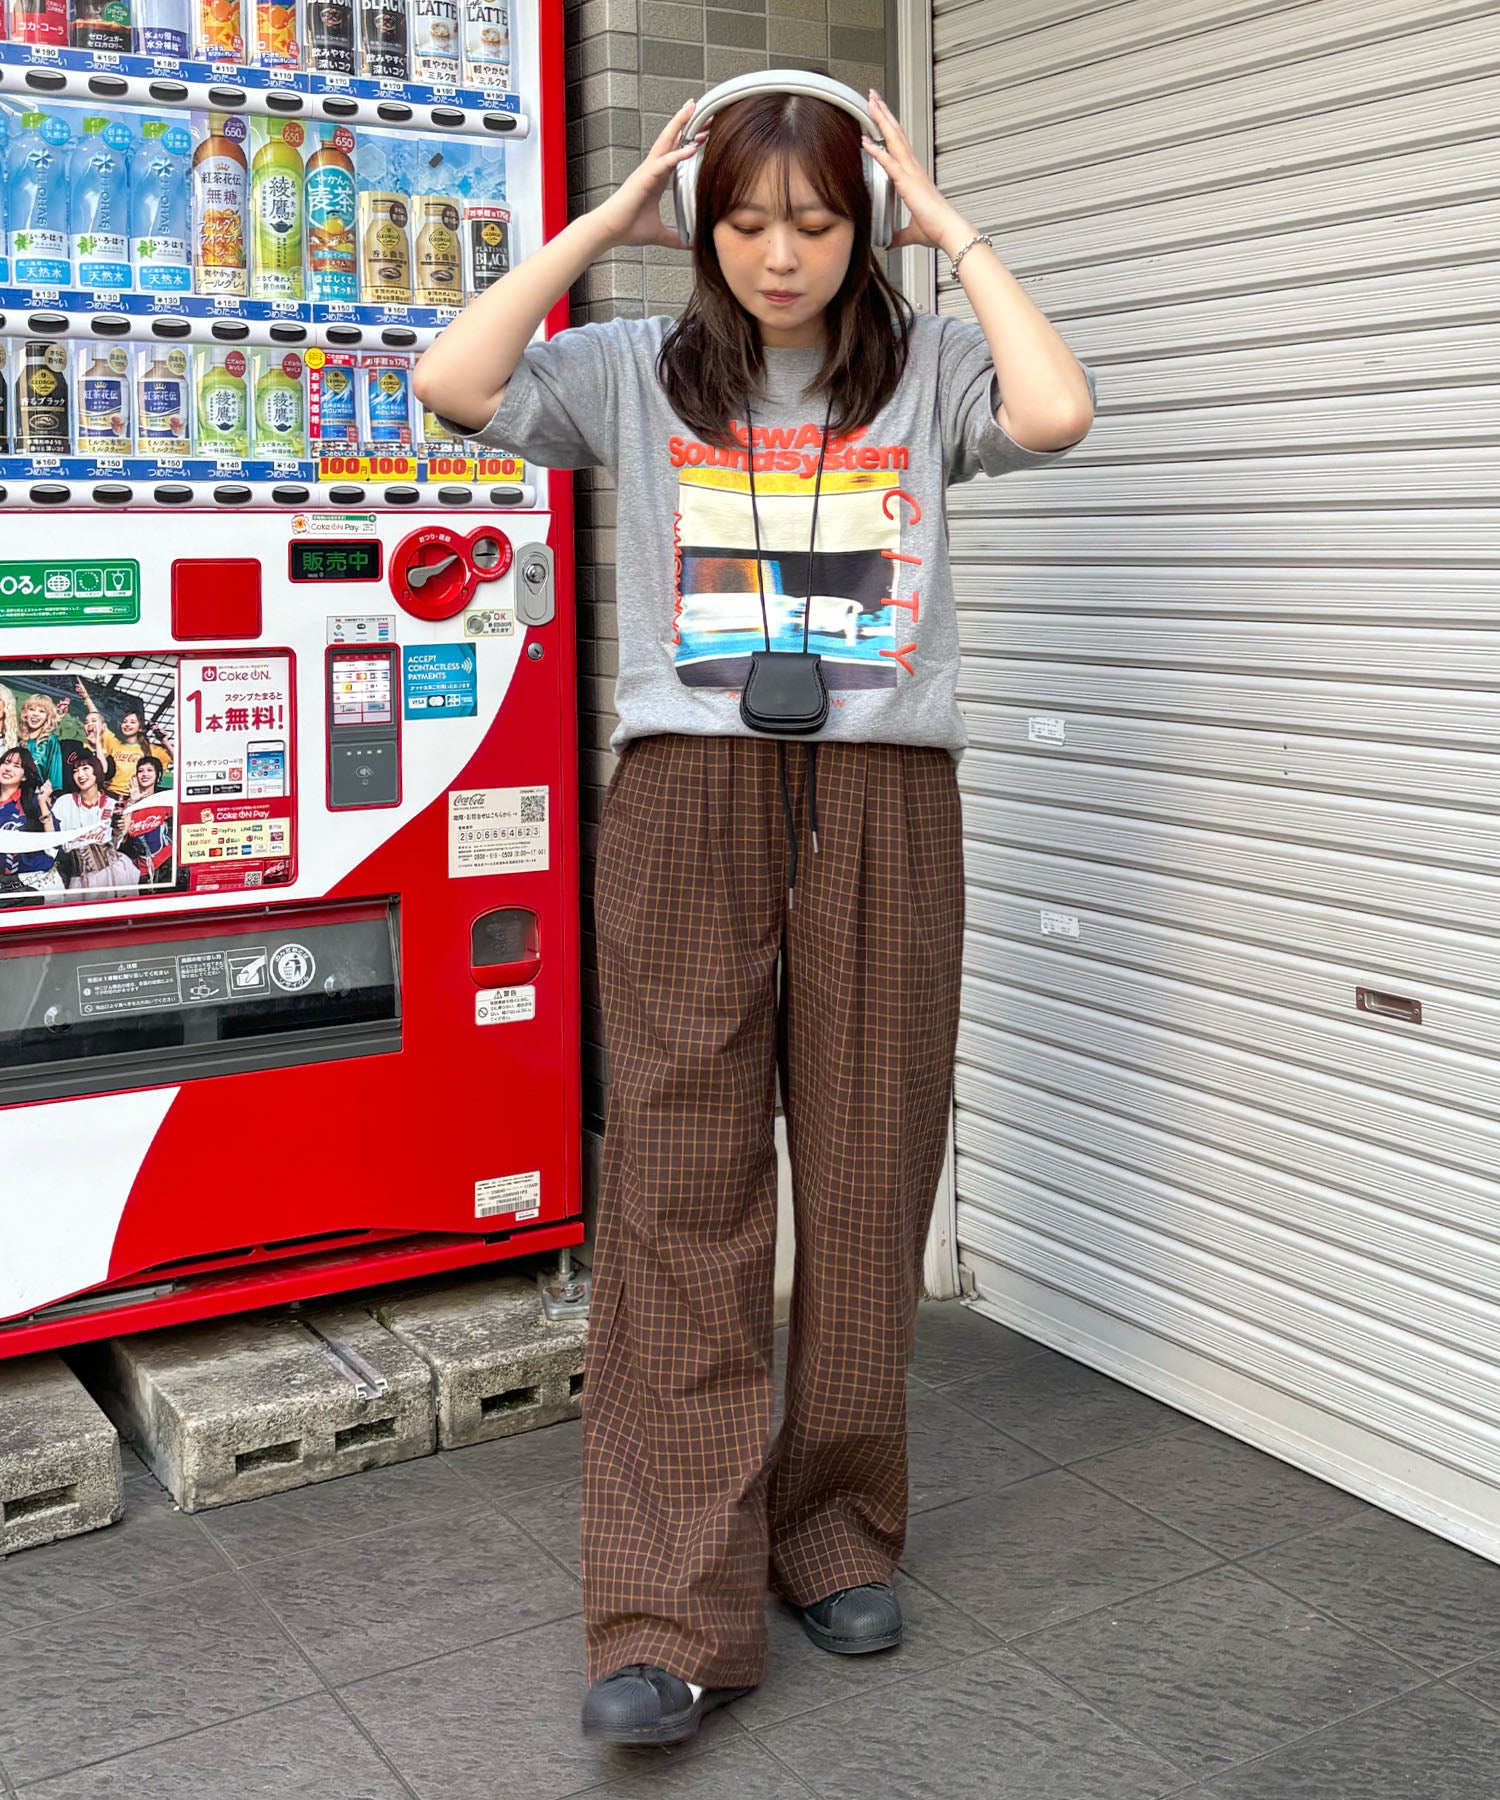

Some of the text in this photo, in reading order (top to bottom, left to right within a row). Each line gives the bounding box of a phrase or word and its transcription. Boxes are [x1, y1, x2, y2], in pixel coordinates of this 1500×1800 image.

[416, 0, 457, 20] LATTE
[467, 7, 508, 26] LATTE
[18, 21, 64, 35] コカ・コーラ
[88, 33, 123, 42] ゼロシュガー
[147, 40, 179, 51] 水分補給
[35, 48, 56, 56] ¥190
[312, 48, 350, 60] 飲みやすく
[97, 55, 117, 63] ¥190
[157, 60, 177, 68] ¥180
[366, 54, 404, 65] 飲みやすく
[319, 60, 351, 71] 深いコク
[373, 65, 405, 77] 深いコク
[273, 72, 292, 80] ¥110
[201, 172, 242, 185] 紅茶花伝
[207, 189, 237, 205] 無糖
[269, 176, 290, 220] 綾鷹
[308, 183, 354, 213] 麦茶
[475, 252, 508, 265] BLACK
[26, 267, 63, 278] 天然水
[89, 271, 125, 282] 天然水
[149, 273, 183, 285] 天然水
[83, 389, 118, 400] 紅茶花伝
[144, 391, 177, 401] 紅茶花伝
[21, 398, 65, 406] 香るブラック
[216, 391, 231, 421] 綾鷹
[273, 392, 289, 422] 綾鷹
[311, 523, 330, 531] Coke
[345, 524, 359, 532] Pay
[303, 551, 368, 571] 販売中
[880, 489, 922, 677] CITY
[408, 655, 436, 663] ACCEPT
[408, 663, 460, 672] CONTACTLESS
[218, 671, 249, 681] Coke
[408, 672, 446, 680] PAYMENTS
[225, 692, 283, 702] スタンプたまると
[216, 811, 237, 820] Coke
[253, 810, 270, 819] Pay
